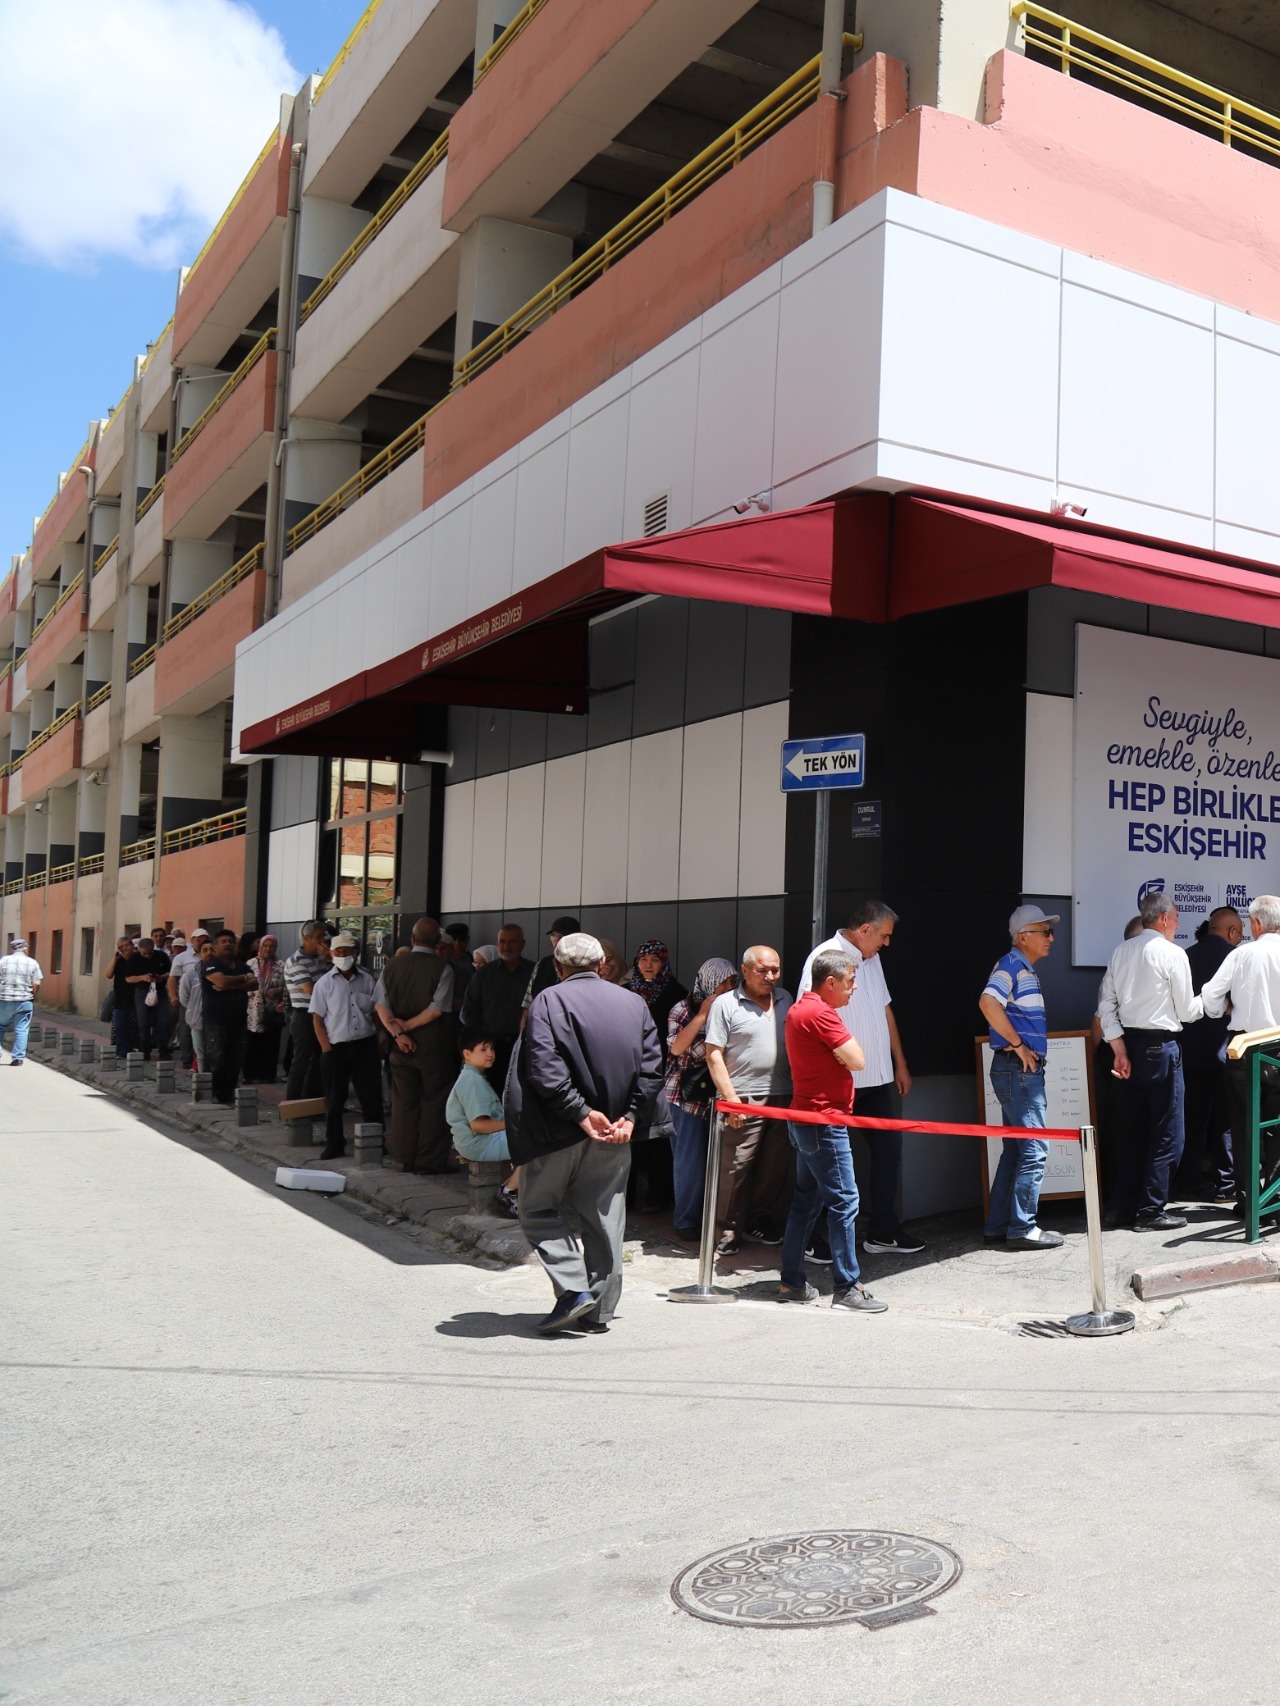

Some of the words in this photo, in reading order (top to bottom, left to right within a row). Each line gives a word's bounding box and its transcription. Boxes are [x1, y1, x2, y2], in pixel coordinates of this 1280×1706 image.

[432, 636, 457, 662] ESKİŞEHİR
[457, 619, 490, 650] BÜYÜKŞEHİR
[490, 601, 523, 633] BELEDİYESİ
[1143, 695, 1254, 750] Sevgiyle,
[803, 756, 828, 773] TEK
[831, 751, 857, 770] YÖN
[1106, 738, 1202, 779] emekle,
[1108, 779, 1167, 813] HEP
[1128, 819, 1267, 861] ESKİŞEHİR
[1174, 882, 1204, 894] ESKİŞEHİR
[1174, 893, 1212, 904] BÜYÜKŞEHİR
[1225, 884, 1247, 897] AYŞE
[1055, 1144, 1074, 1156] TL
